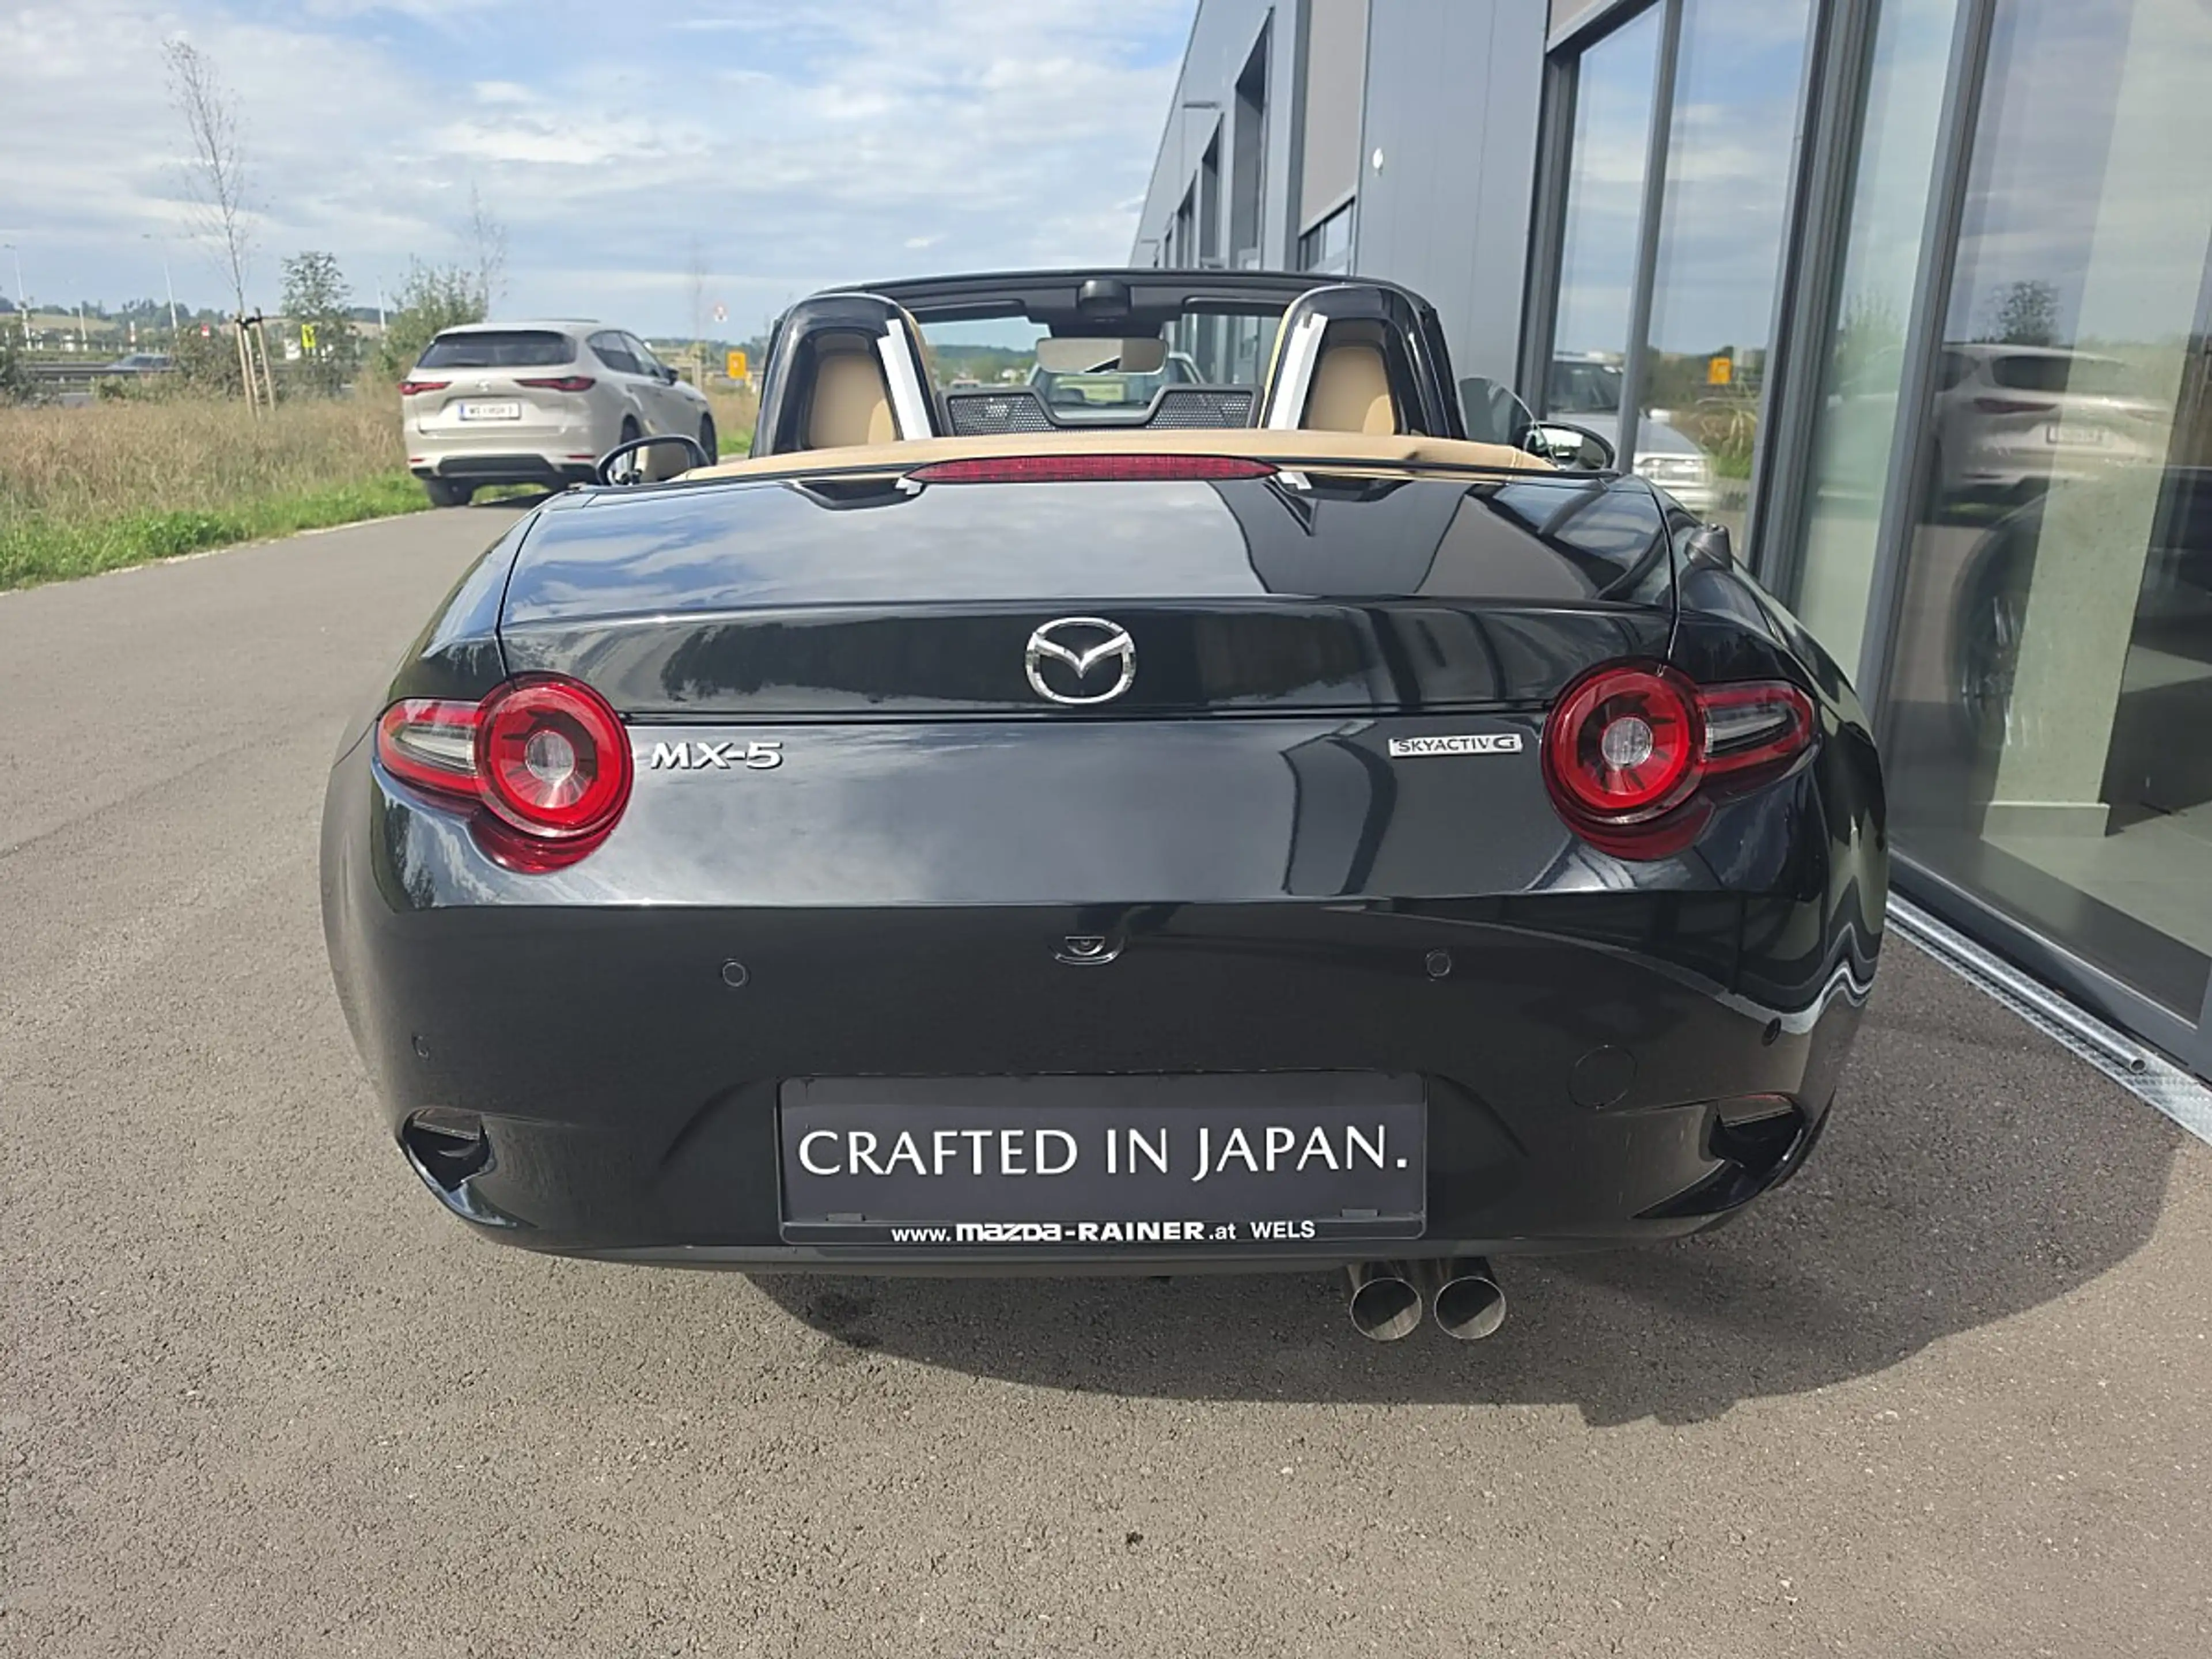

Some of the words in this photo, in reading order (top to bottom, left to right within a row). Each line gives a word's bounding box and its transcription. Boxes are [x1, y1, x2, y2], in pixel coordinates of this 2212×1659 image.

[650, 741, 784, 770] MX-5
[798, 1128, 1078, 1176] CRAFTED
[1106, 1127, 1169, 1175] IN
[1190, 1125, 1408, 1183] JAPAN.
[1249, 1219, 1317, 1240] WELS
